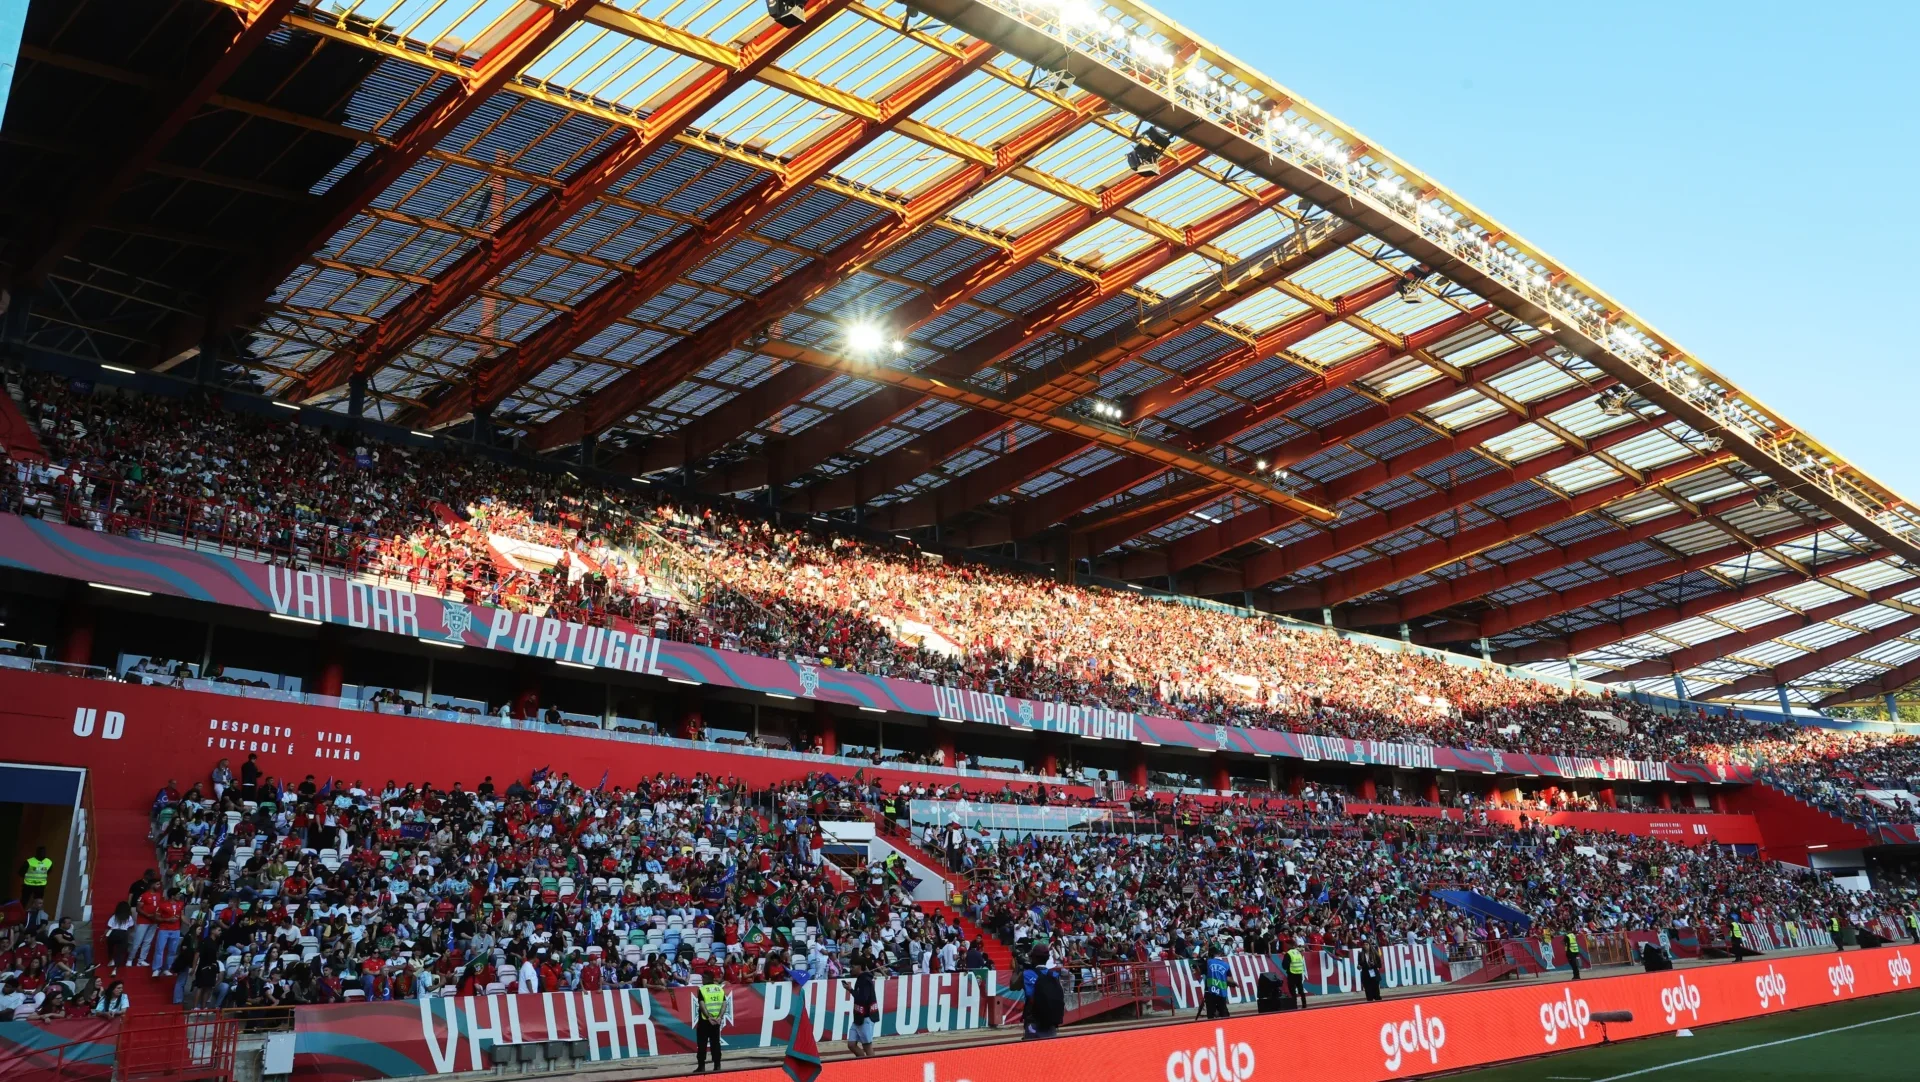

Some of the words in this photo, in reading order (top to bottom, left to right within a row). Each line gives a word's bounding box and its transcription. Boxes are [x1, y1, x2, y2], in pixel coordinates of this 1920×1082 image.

[268, 565, 332, 623] VAI
[346, 580, 419, 637] DAR
[486, 608, 664, 676] PORTUGAL
[932, 685, 967, 721] VAI
[968, 690, 1010, 726] DAR
[1042, 701, 1139, 741] PORTUGAL
[207, 737, 277, 754] FUTEBOL
[287, 743, 294, 756] É
[315, 747, 361, 761] AIXÃO
[209, 719, 292, 738] DESPORTO
[317, 731, 352, 745] VIDA
[1296, 733, 1321, 760] VAI
[1320, 736, 1349, 762] DAR
[1370, 740, 1438, 769] PORTUGAL
[1555, 756, 1576, 778] VAI
[1574, 757, 1598, 779] DAR
[1613, 758, 1671, 781] PORTUGAL
[1380, 1004, 1446, 1072] galp
[1539, 987, 1591, 1046] galp
[1661, 974, 1701, 1025] galp
[1755, 963, 1787, 1009] galp
[1828, 956, 1855, 997] galp
[1887, 949, 1912, 987] galp
